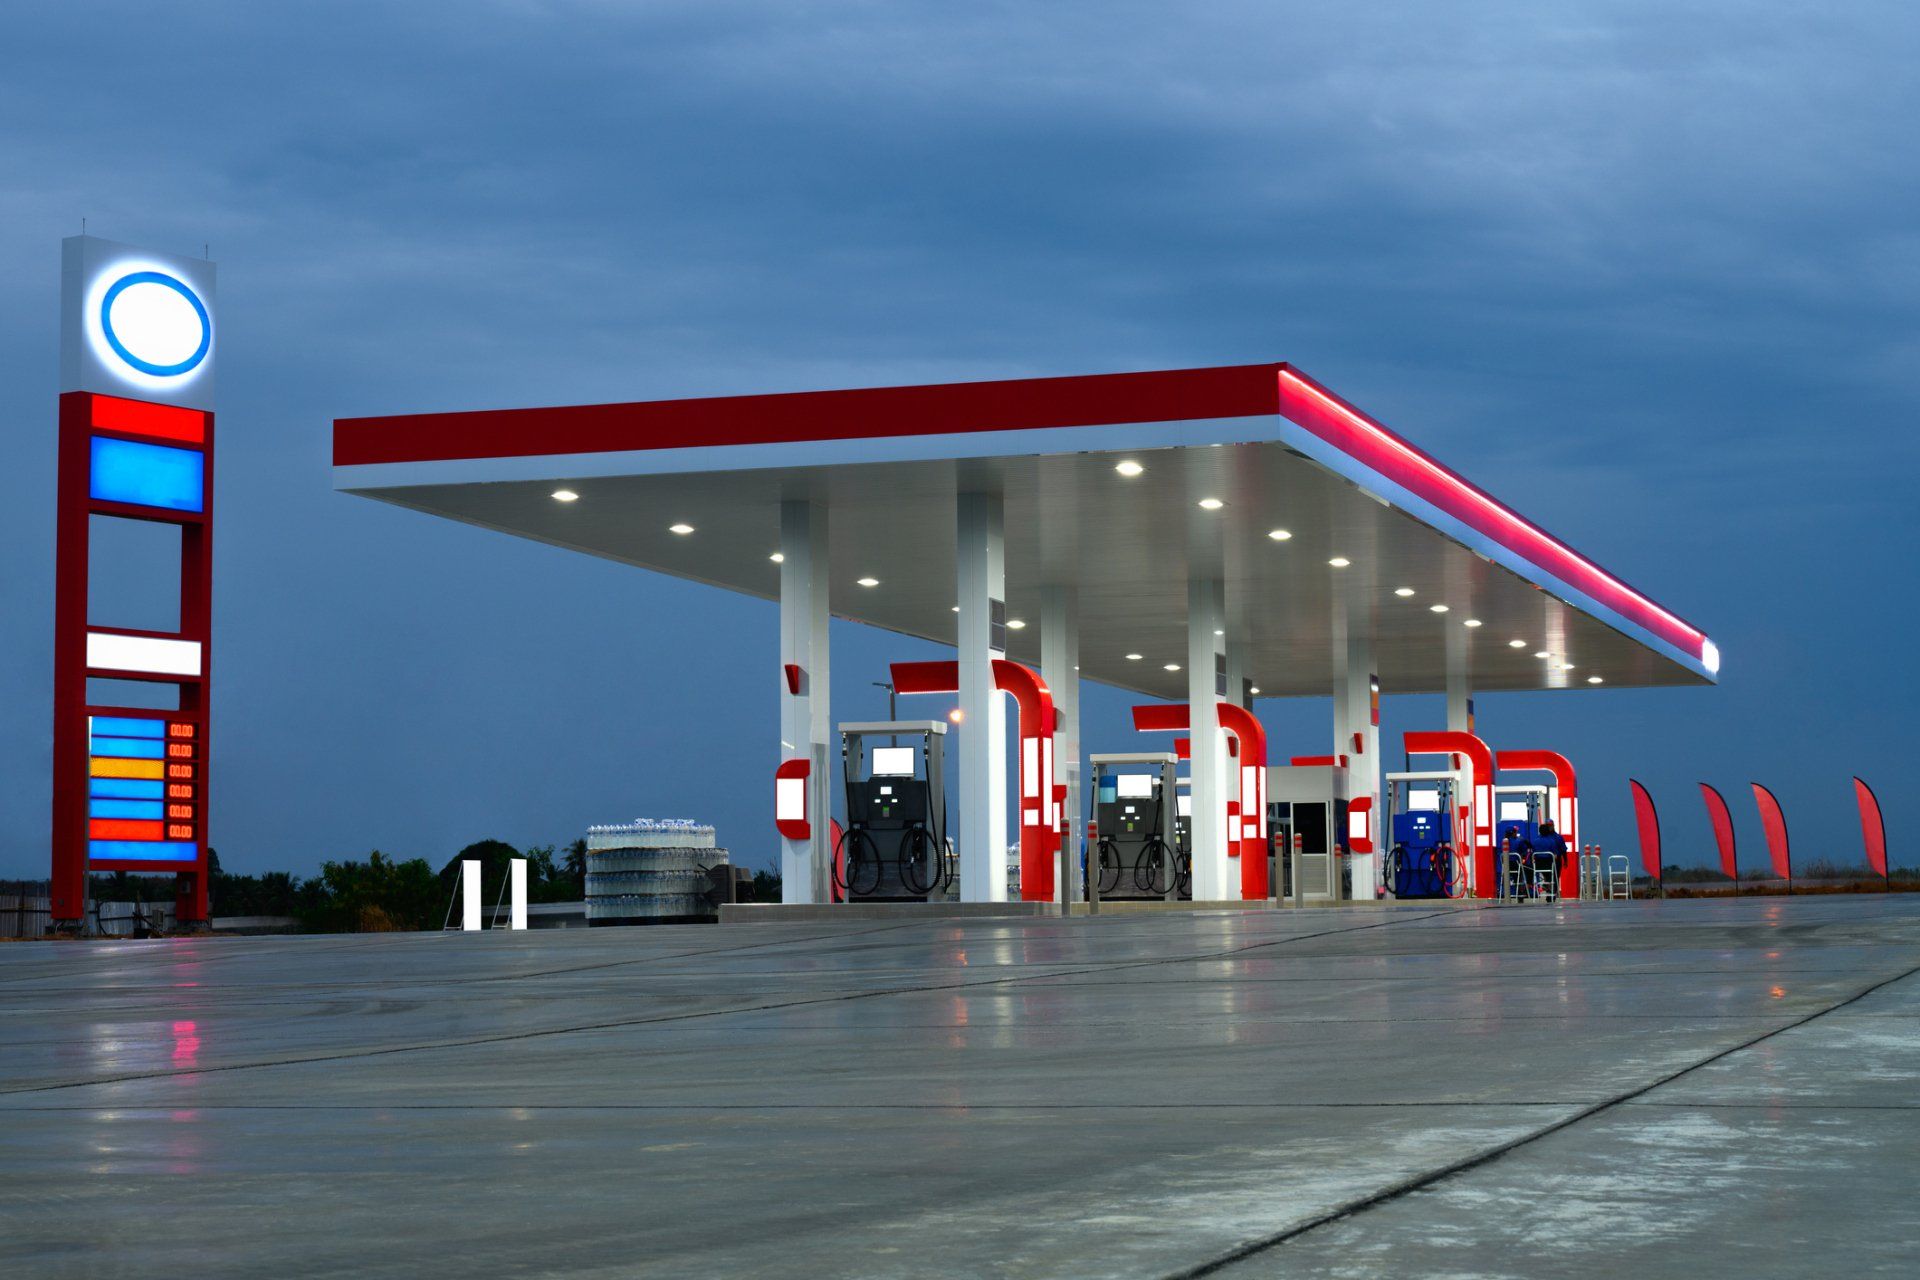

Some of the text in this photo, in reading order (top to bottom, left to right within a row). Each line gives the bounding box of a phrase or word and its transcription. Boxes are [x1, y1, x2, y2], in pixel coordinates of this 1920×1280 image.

[170, 723, 193, 738] 00.00
[169, 743, 192, 758] 00.00
[169, 763, 192, 778] 00.00
[169, 783, 192, 798] 00.00
[169, 804, 192, 819] 00.00
[169, 824, 192, 839] 00.00
